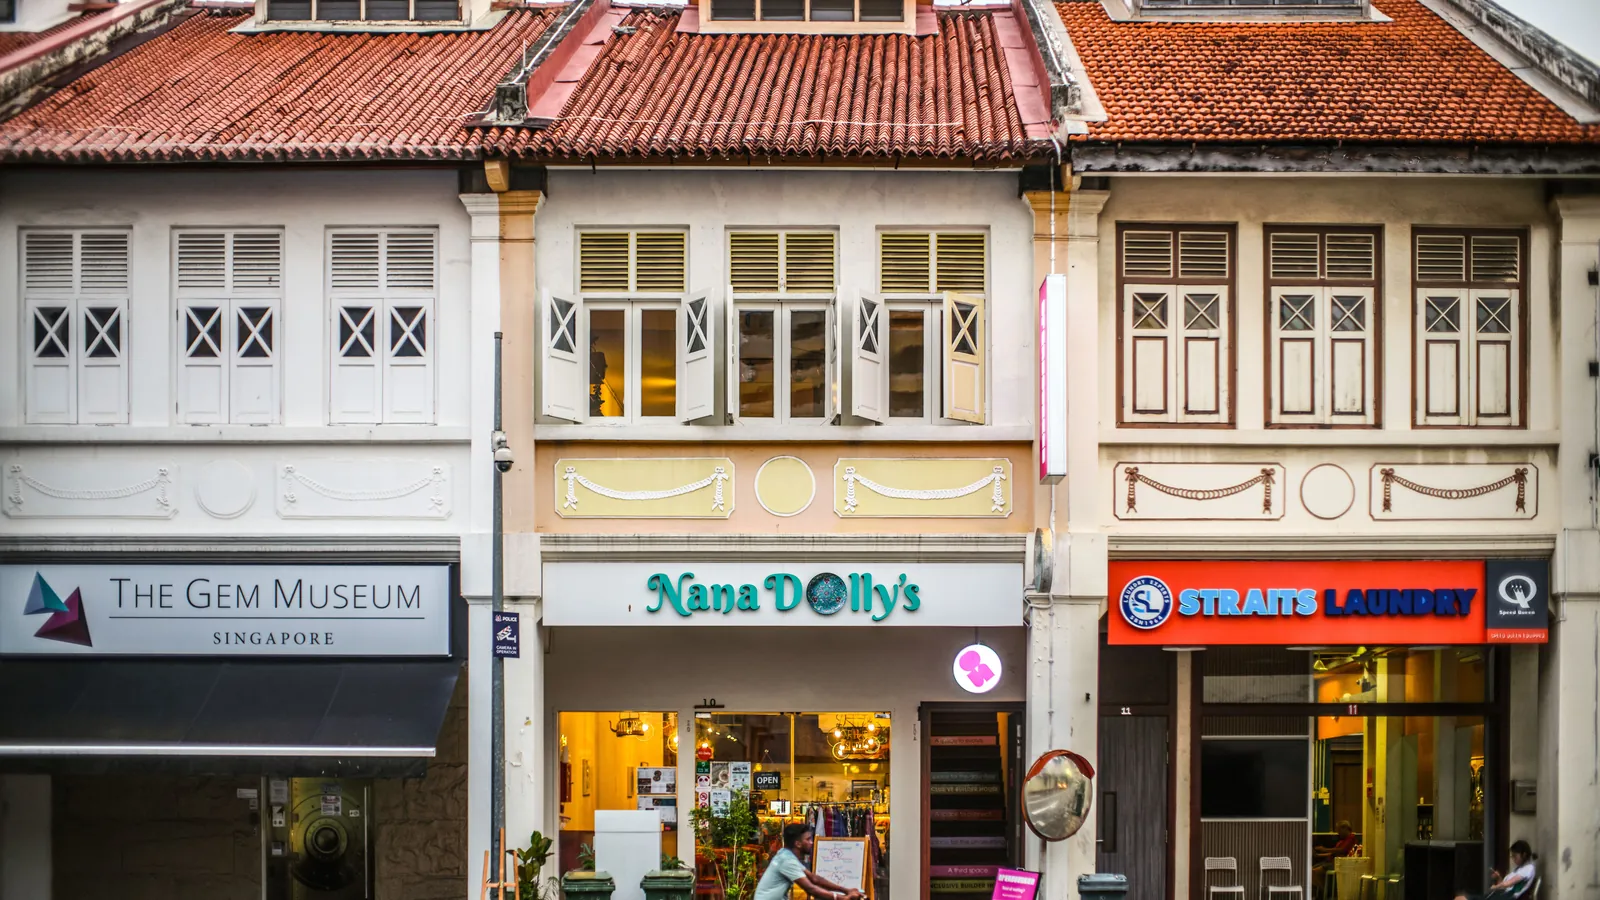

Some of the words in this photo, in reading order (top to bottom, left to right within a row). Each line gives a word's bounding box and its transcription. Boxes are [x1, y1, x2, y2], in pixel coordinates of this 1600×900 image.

[110, 578, 173, 608] THE
[186, 578, 259, 609] GEM
[274, 579, 420, 609] MUSEUM
[646, 572, 760, 616] Nana
[1123, 580, 1145, 603] LAUNDRY
[1150, 580, 1170, 603] EXPERTS
[1178, 588, 1317, 616] STRAITS
[1324, 588, 1478, 617] LAUNDRY
[213, 632, 334, 645] SINGAPORE
[1121, 707, 1132, 715] 11
[756, 776, 778, 785] OPEN
